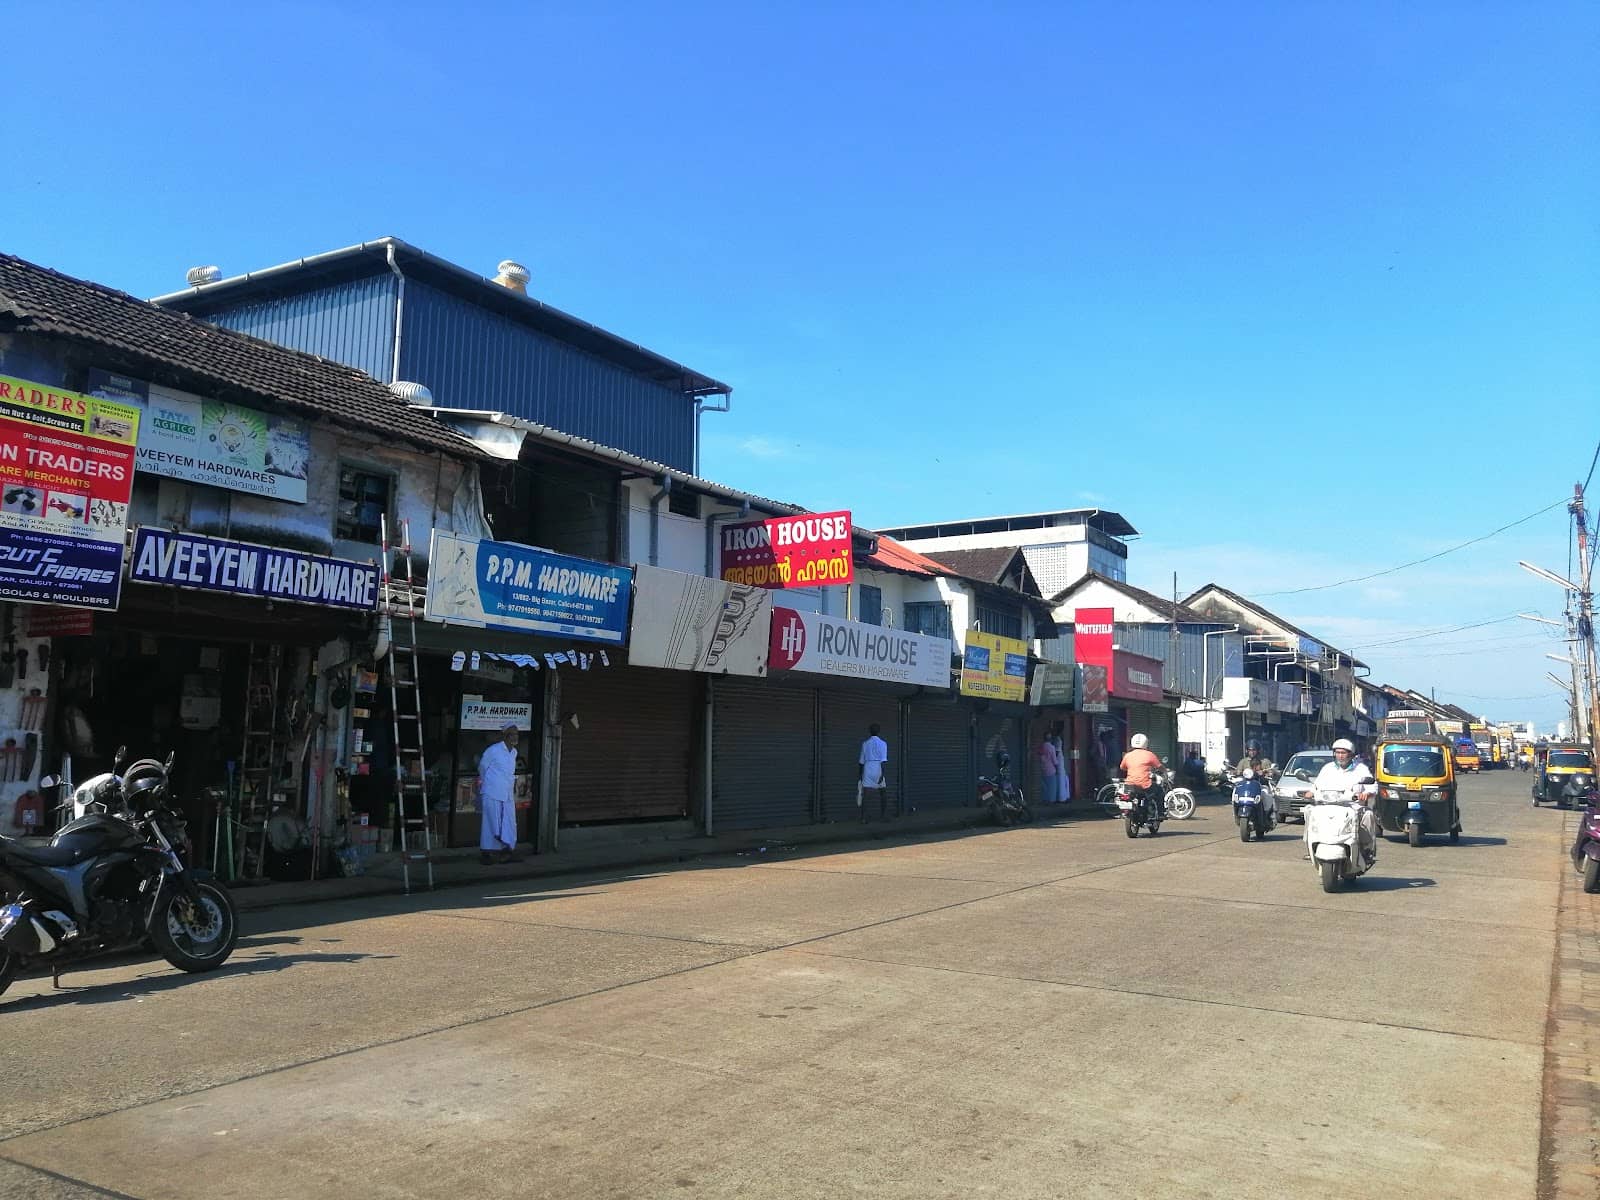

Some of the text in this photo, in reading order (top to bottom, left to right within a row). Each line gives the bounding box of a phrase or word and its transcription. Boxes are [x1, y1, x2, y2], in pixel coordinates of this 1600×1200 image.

[154, 418, 196, 435] AGRICO
[159, 409, 191, 423] TATA
[0, 444, 18, 462] N
[25, 447, 125, 482] TRADERS
[198, 459, 276, 485] HARDWARES
[24, 469, 91, 489] MERCHANTS
[725, 516, 848, 551] IRON HOUSE
[42, 563, 116, 584] FIBRES
[135, 535, 377, 606] AVEEYEM HARDWARE
[486, 554, 620, 604] P.P.M. HARDWARE
[0, 588, 40, 599] GOLAS
[53, 593, 110, 605] MOULDERS
[1075, 622, 1113, 635] WHITEFIELD
[817, 622, 860, 658] IRON
[864, 632, 918, 667] HOUSE
[820, 659, 858, 673] DEALERS
[867, 665, 909, 680] HARDWARE
[467, 705, 488, 715] P.P.M.
[489, 705, 529, 717] HARDWARE
